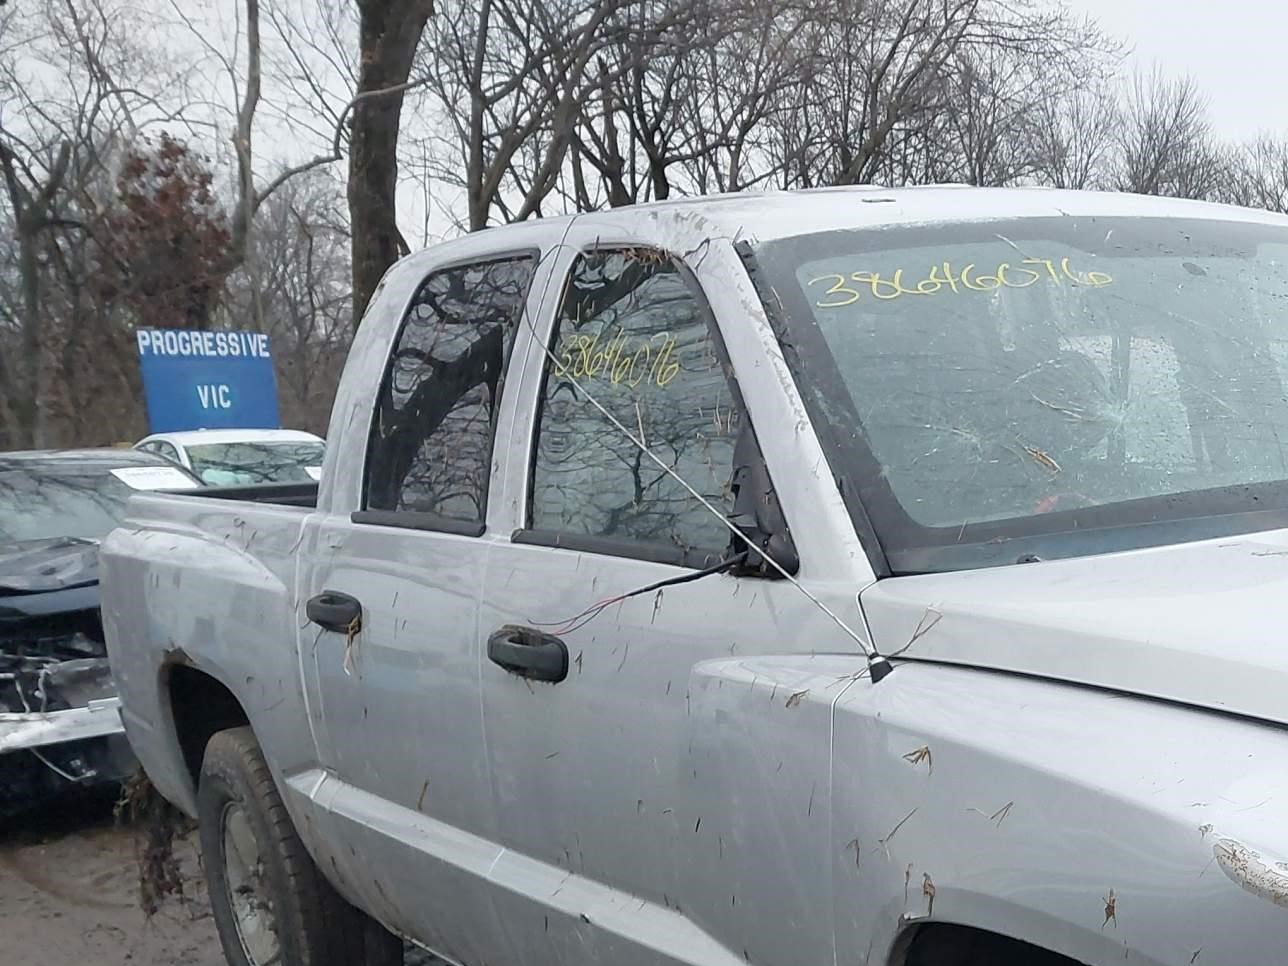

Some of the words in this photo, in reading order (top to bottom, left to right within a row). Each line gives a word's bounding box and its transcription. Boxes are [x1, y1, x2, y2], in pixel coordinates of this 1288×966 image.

[808, 256, 1114, 308] 38646076
[136, 330, 270, 358] PROGRESSIVE
[554, 327, 680, 388] 38646076
[196, 384, 232, 409] VIC
